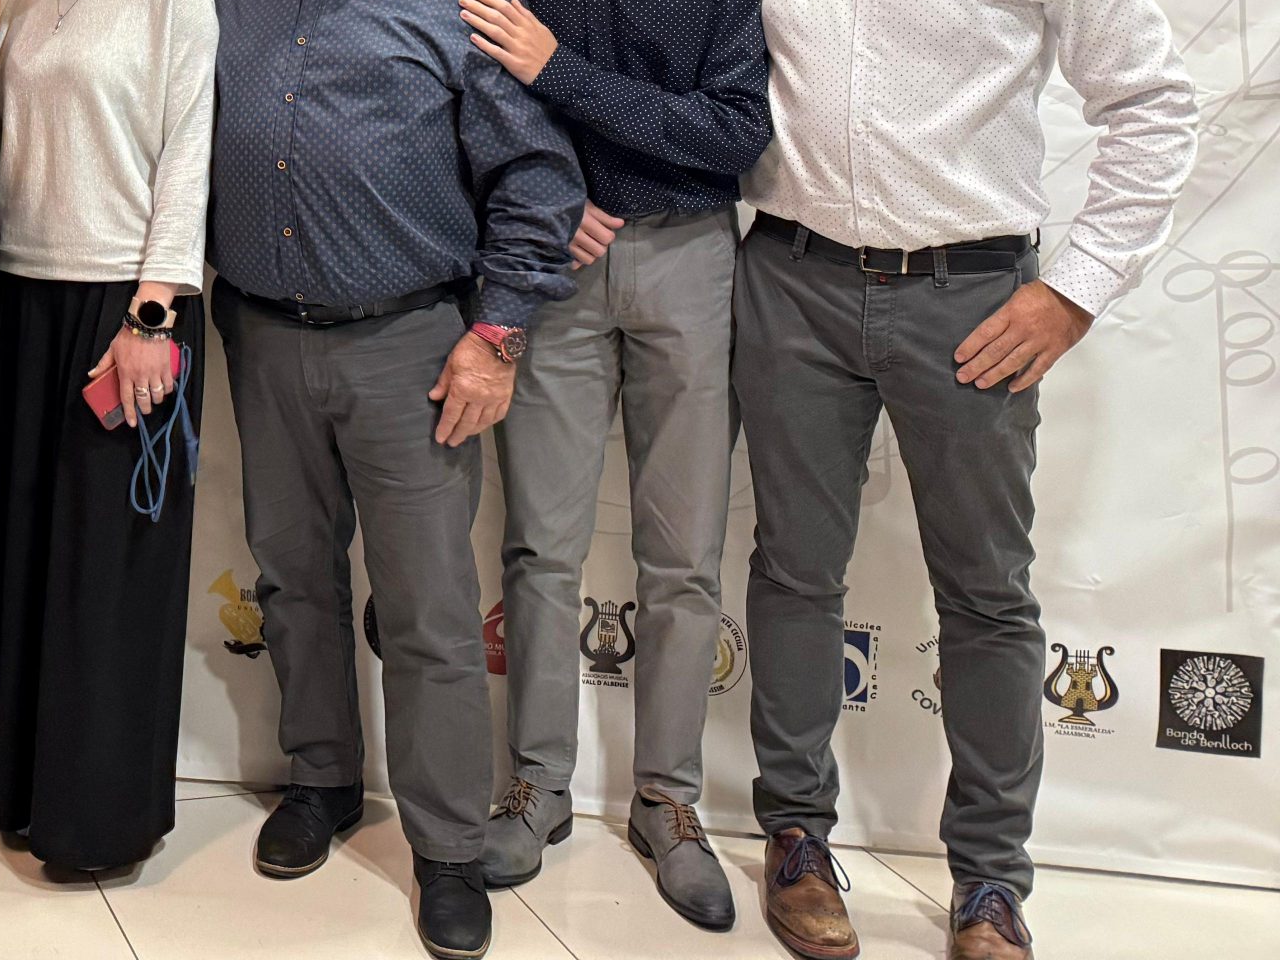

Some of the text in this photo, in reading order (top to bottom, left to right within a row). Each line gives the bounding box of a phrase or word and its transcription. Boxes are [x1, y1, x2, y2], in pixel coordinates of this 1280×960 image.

[1166, 727, 1253, 752] Banda de Benlloch
